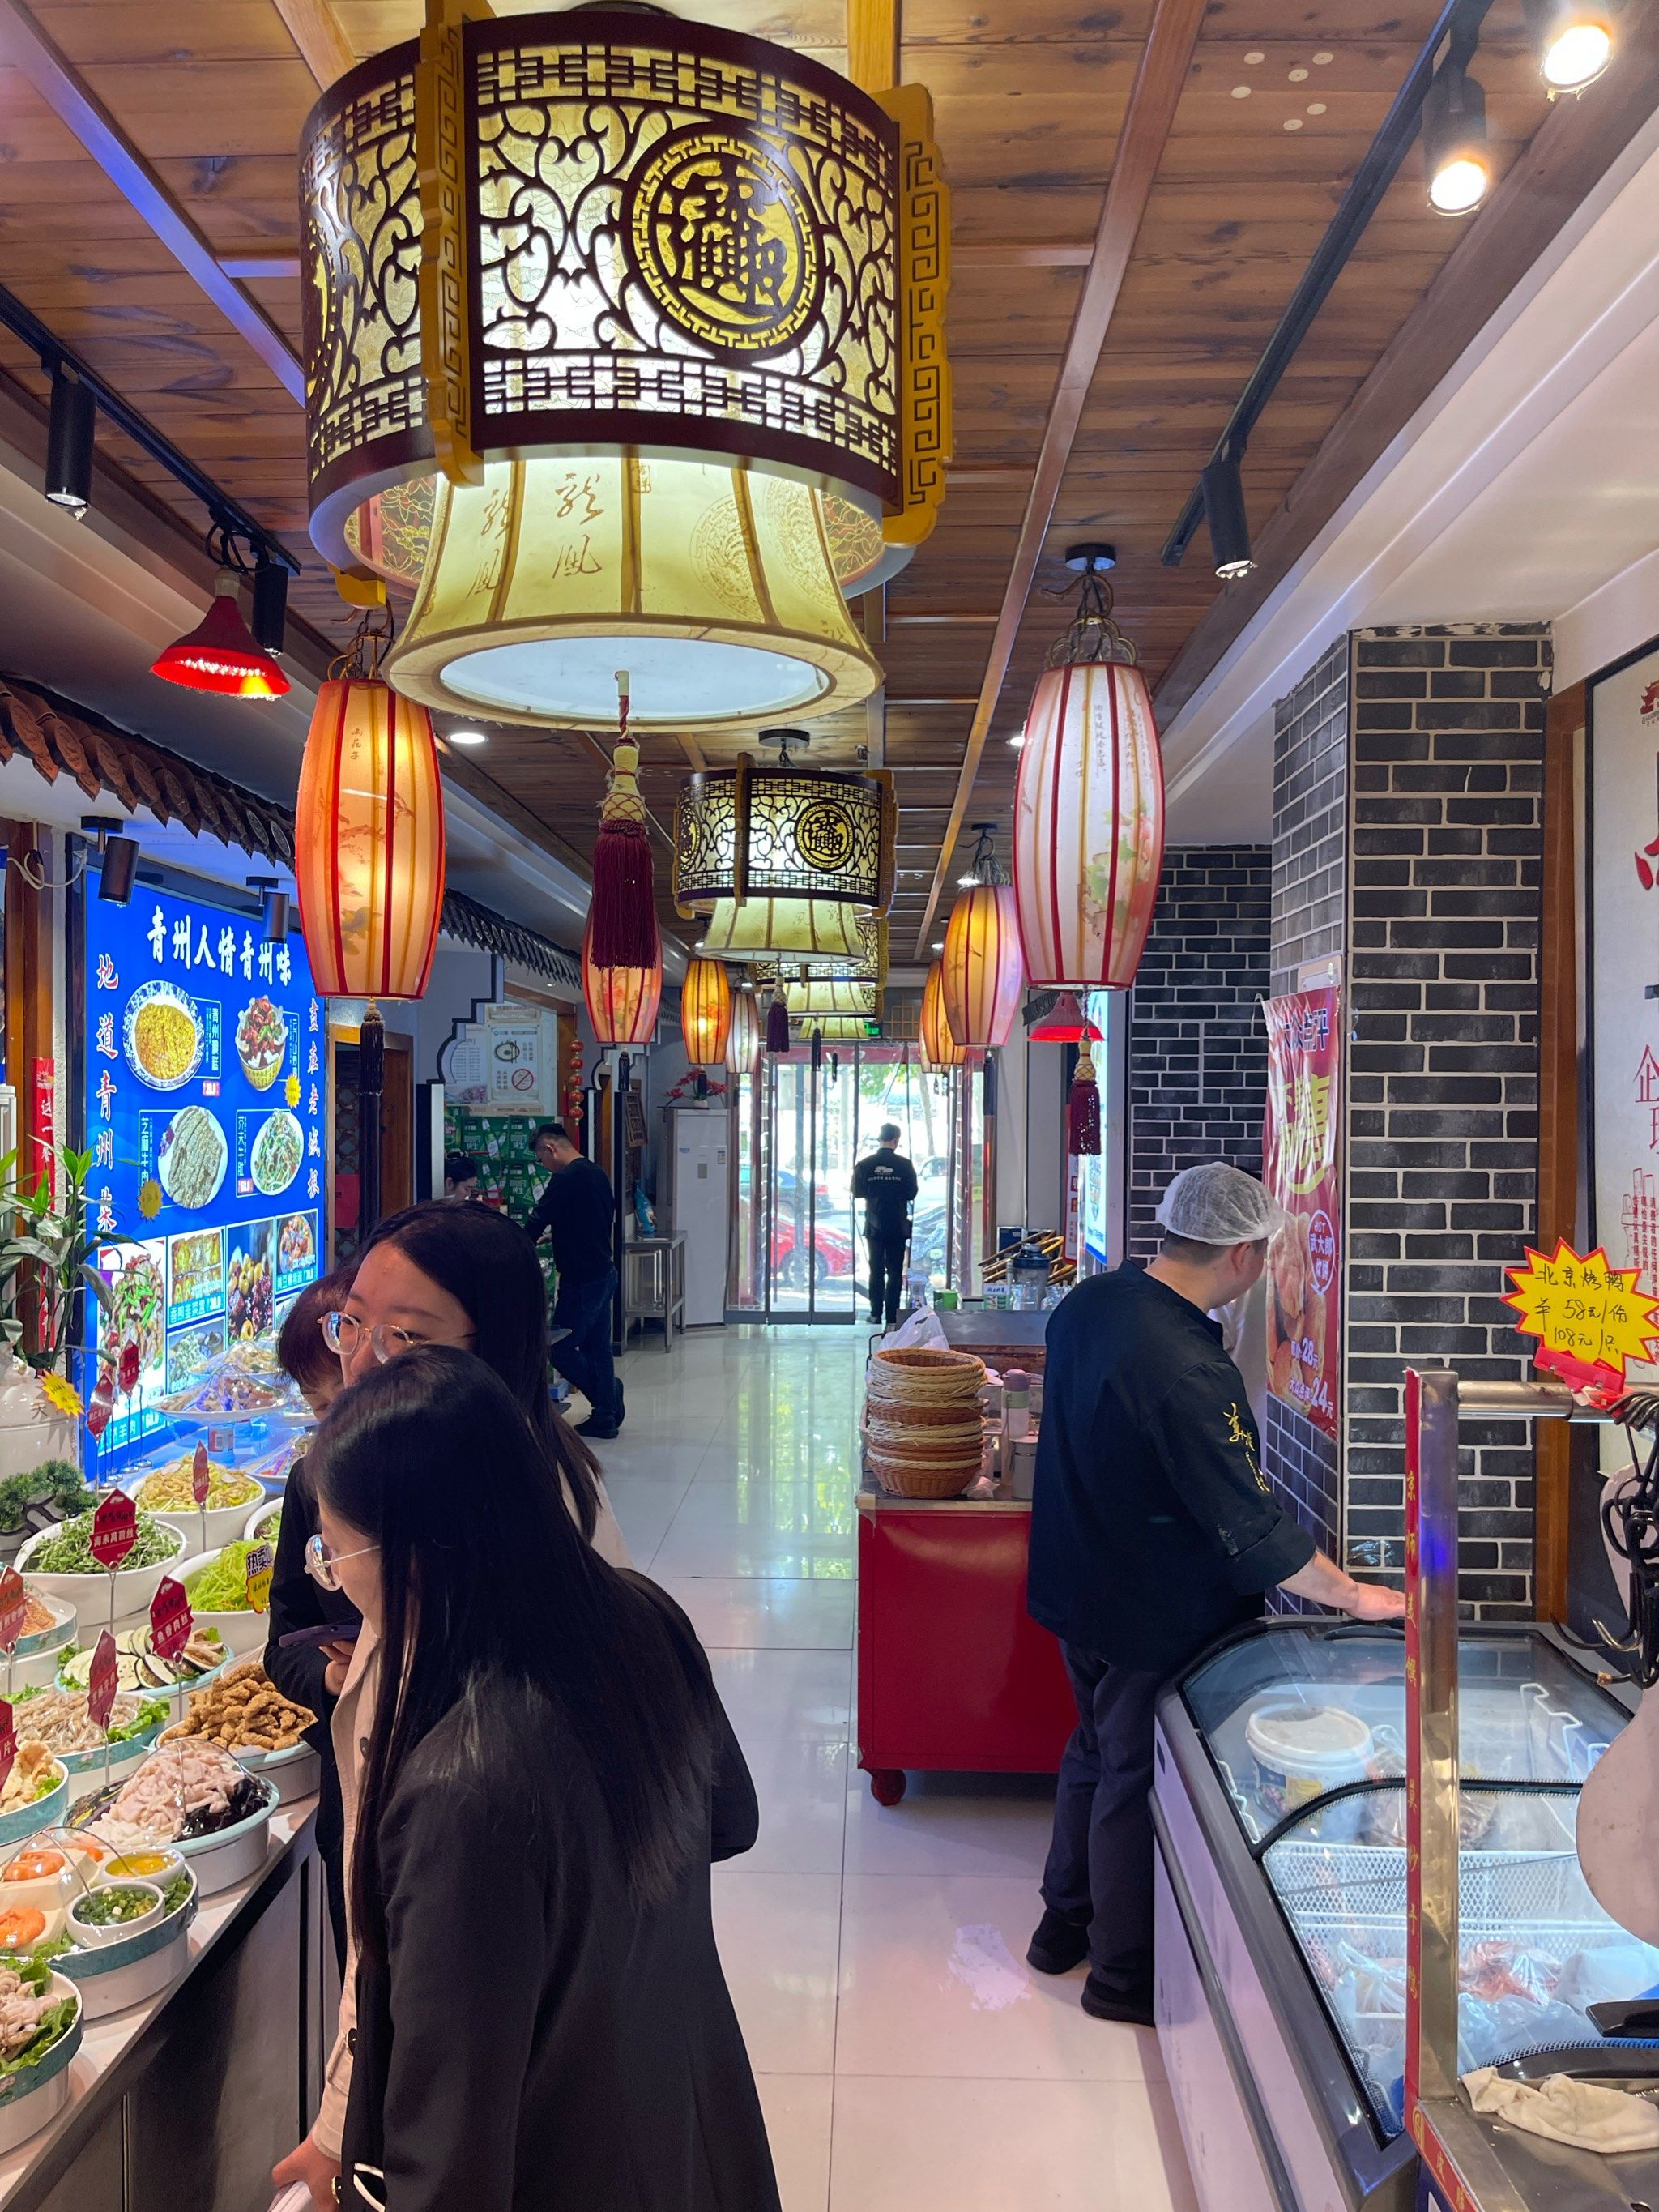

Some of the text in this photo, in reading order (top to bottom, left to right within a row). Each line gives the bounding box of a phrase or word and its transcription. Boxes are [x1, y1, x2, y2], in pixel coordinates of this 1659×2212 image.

[147, 904, 292, 987] 青州人情青州味
[96, 953, 119, 1232] 地道青州菜
[1534, 1263, 1624, 1292] 北京烤鸭
[1554, 1326, 1619, 1356] 108元/只
